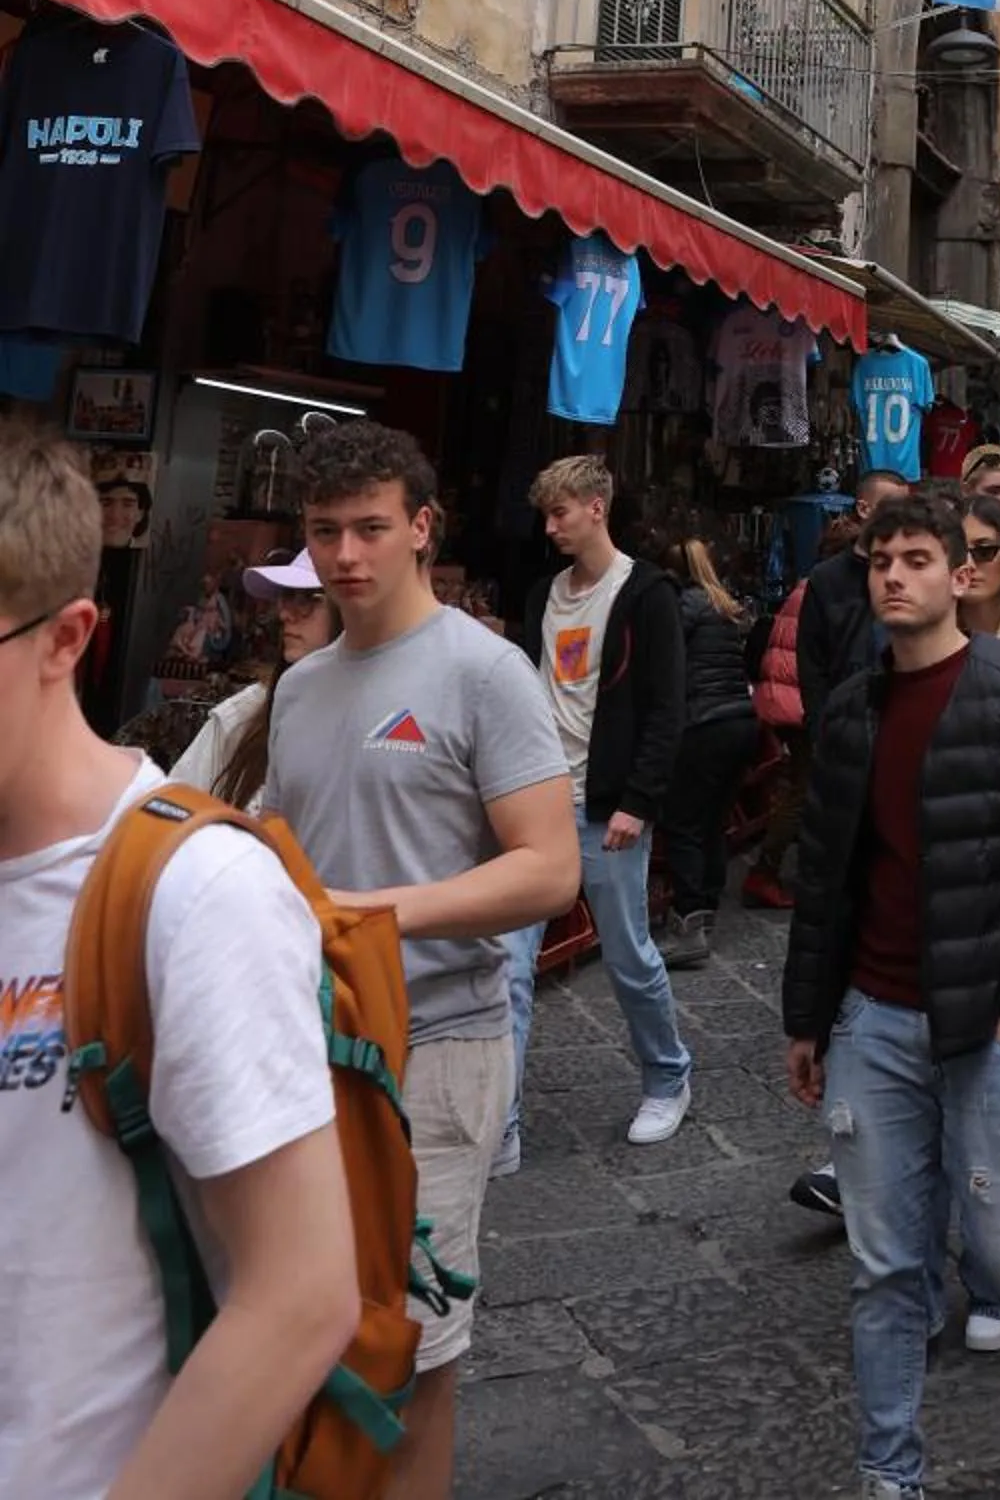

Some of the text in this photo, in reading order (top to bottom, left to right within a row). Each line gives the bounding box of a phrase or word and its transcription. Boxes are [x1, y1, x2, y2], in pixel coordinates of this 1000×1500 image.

[28, 116, 144, 149] NAPOLI
[389, 203, 438, 284] 9
[575, 271, 630, 347] 77
[865, 394, 911, 444] 10
